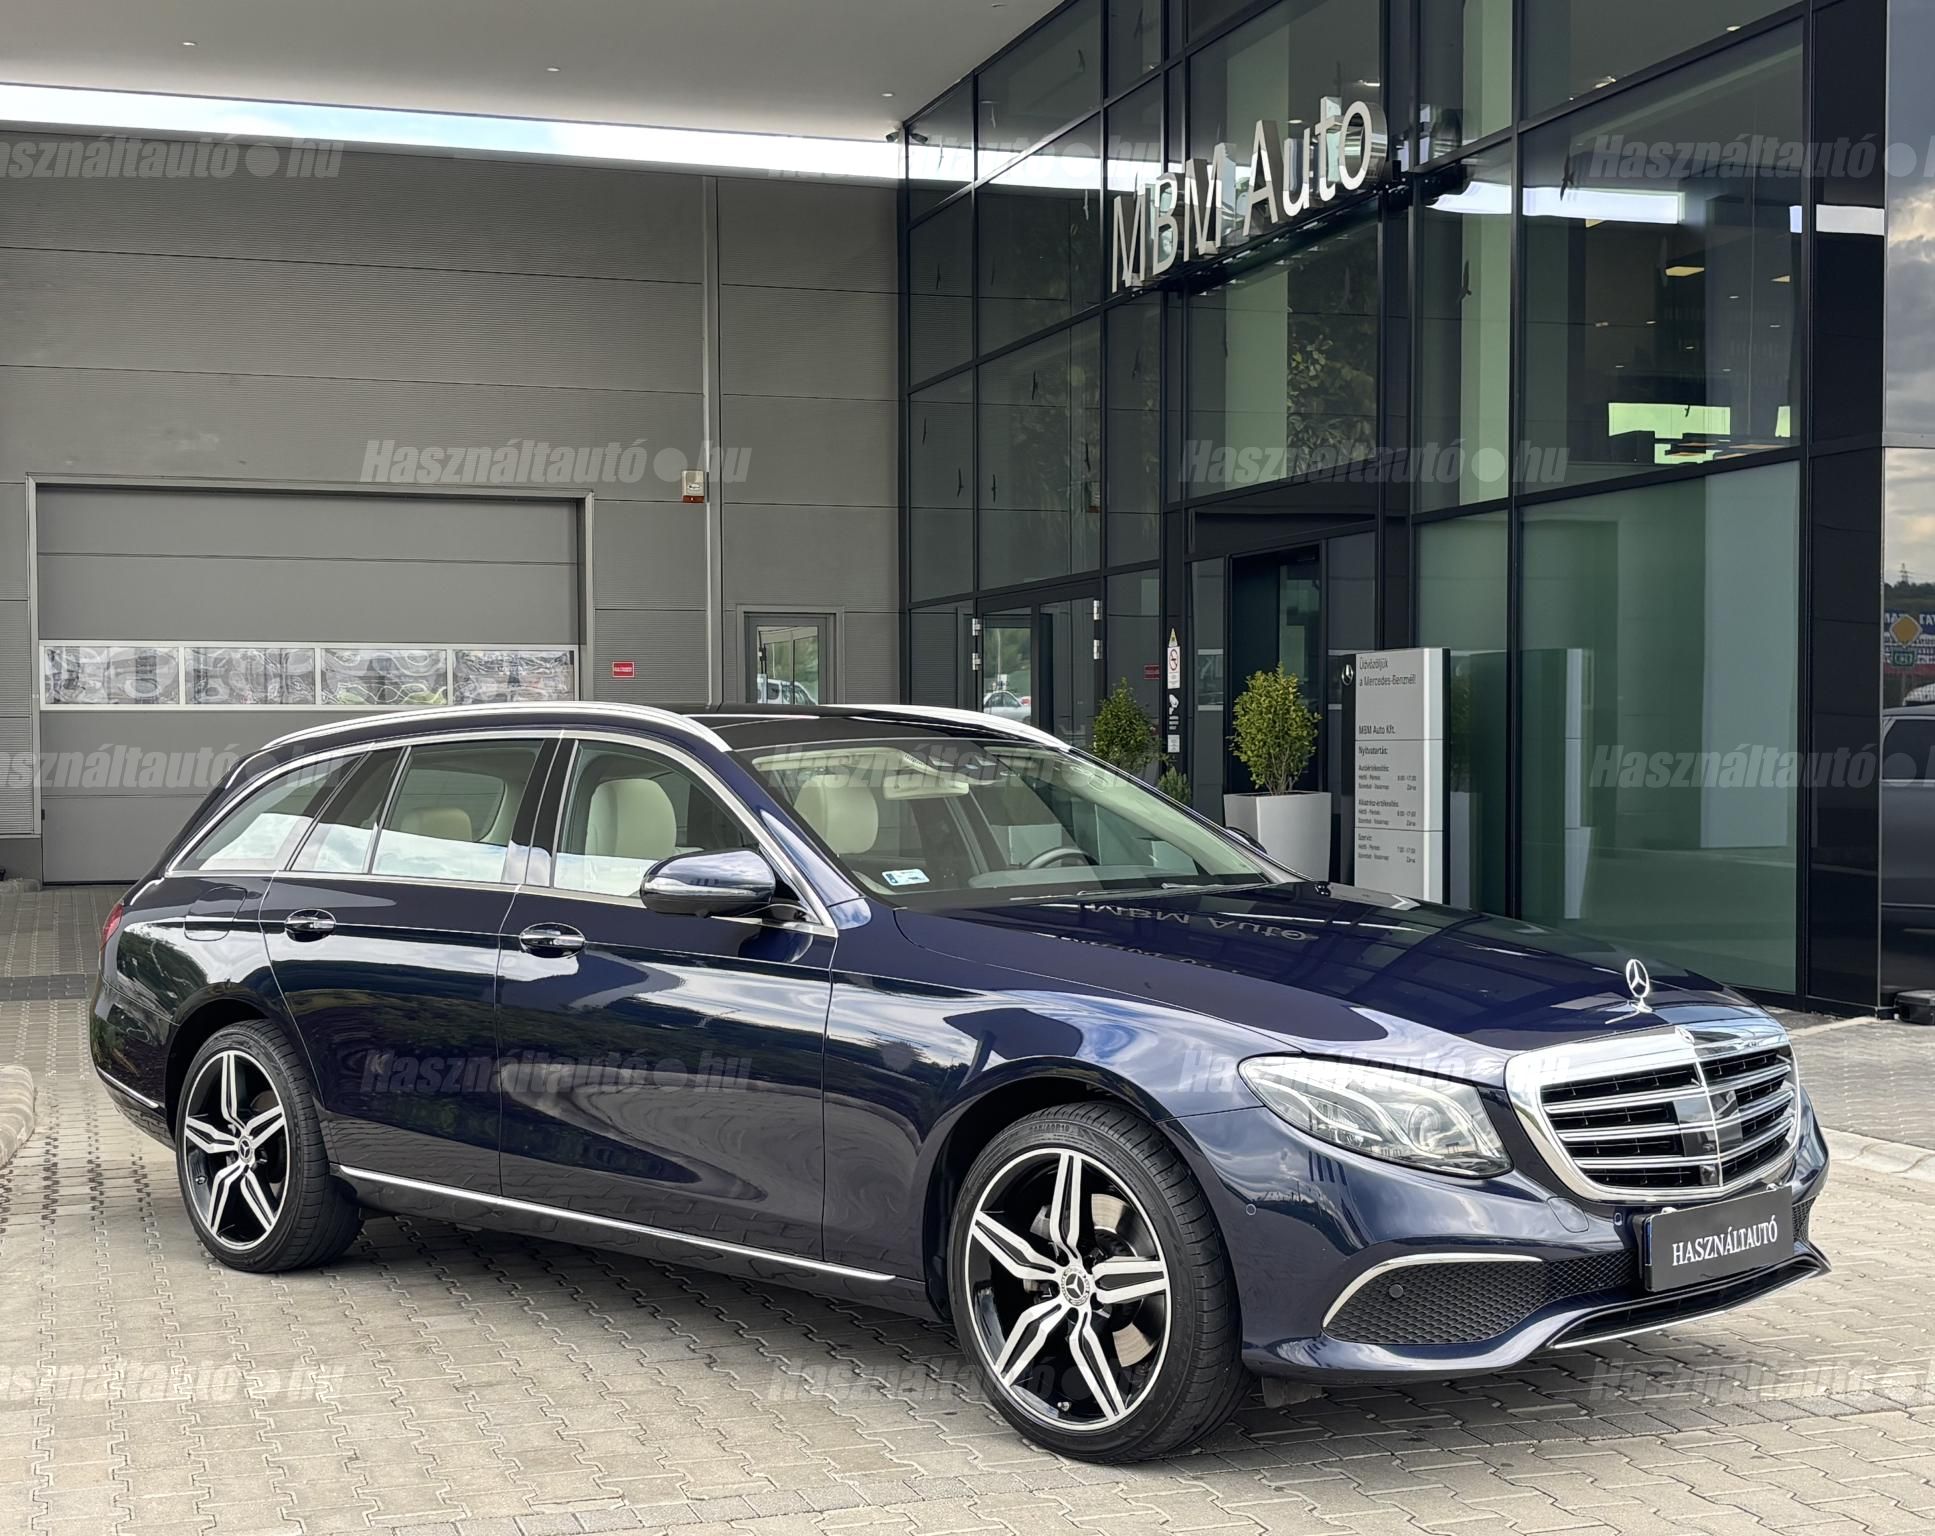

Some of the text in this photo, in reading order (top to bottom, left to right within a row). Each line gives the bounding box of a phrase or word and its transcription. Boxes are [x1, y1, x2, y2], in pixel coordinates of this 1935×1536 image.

[1111, 96, 1387, 294] MBM Auto
[1373, 725, 1385, 735] Auto
[1671, 1214, 1778, 1267] HASZNÁLTAUTÓ
